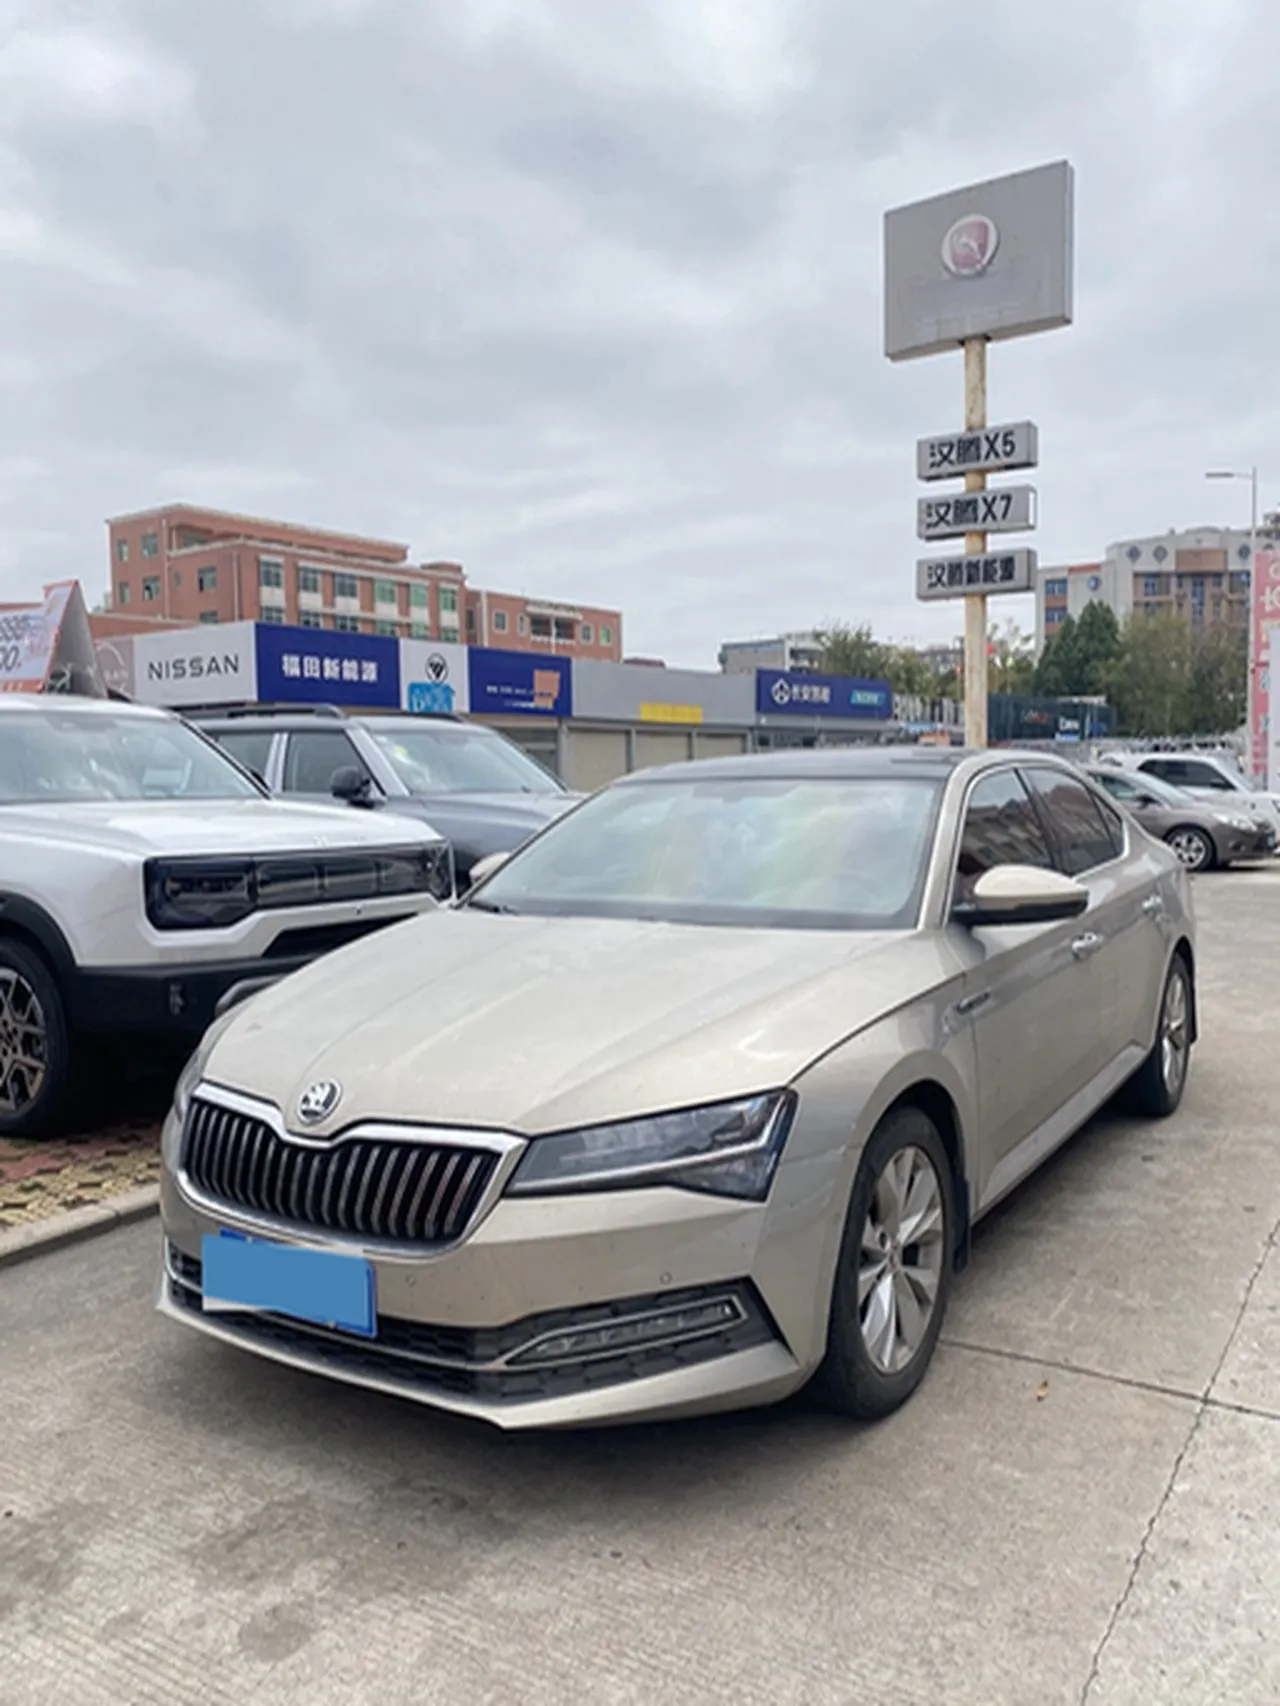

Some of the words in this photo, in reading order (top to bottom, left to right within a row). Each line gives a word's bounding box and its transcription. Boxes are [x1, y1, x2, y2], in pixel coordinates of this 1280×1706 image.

[148, 654, 239, 680] NISSAN
[282, 654, 378, 683] 福田新能源
